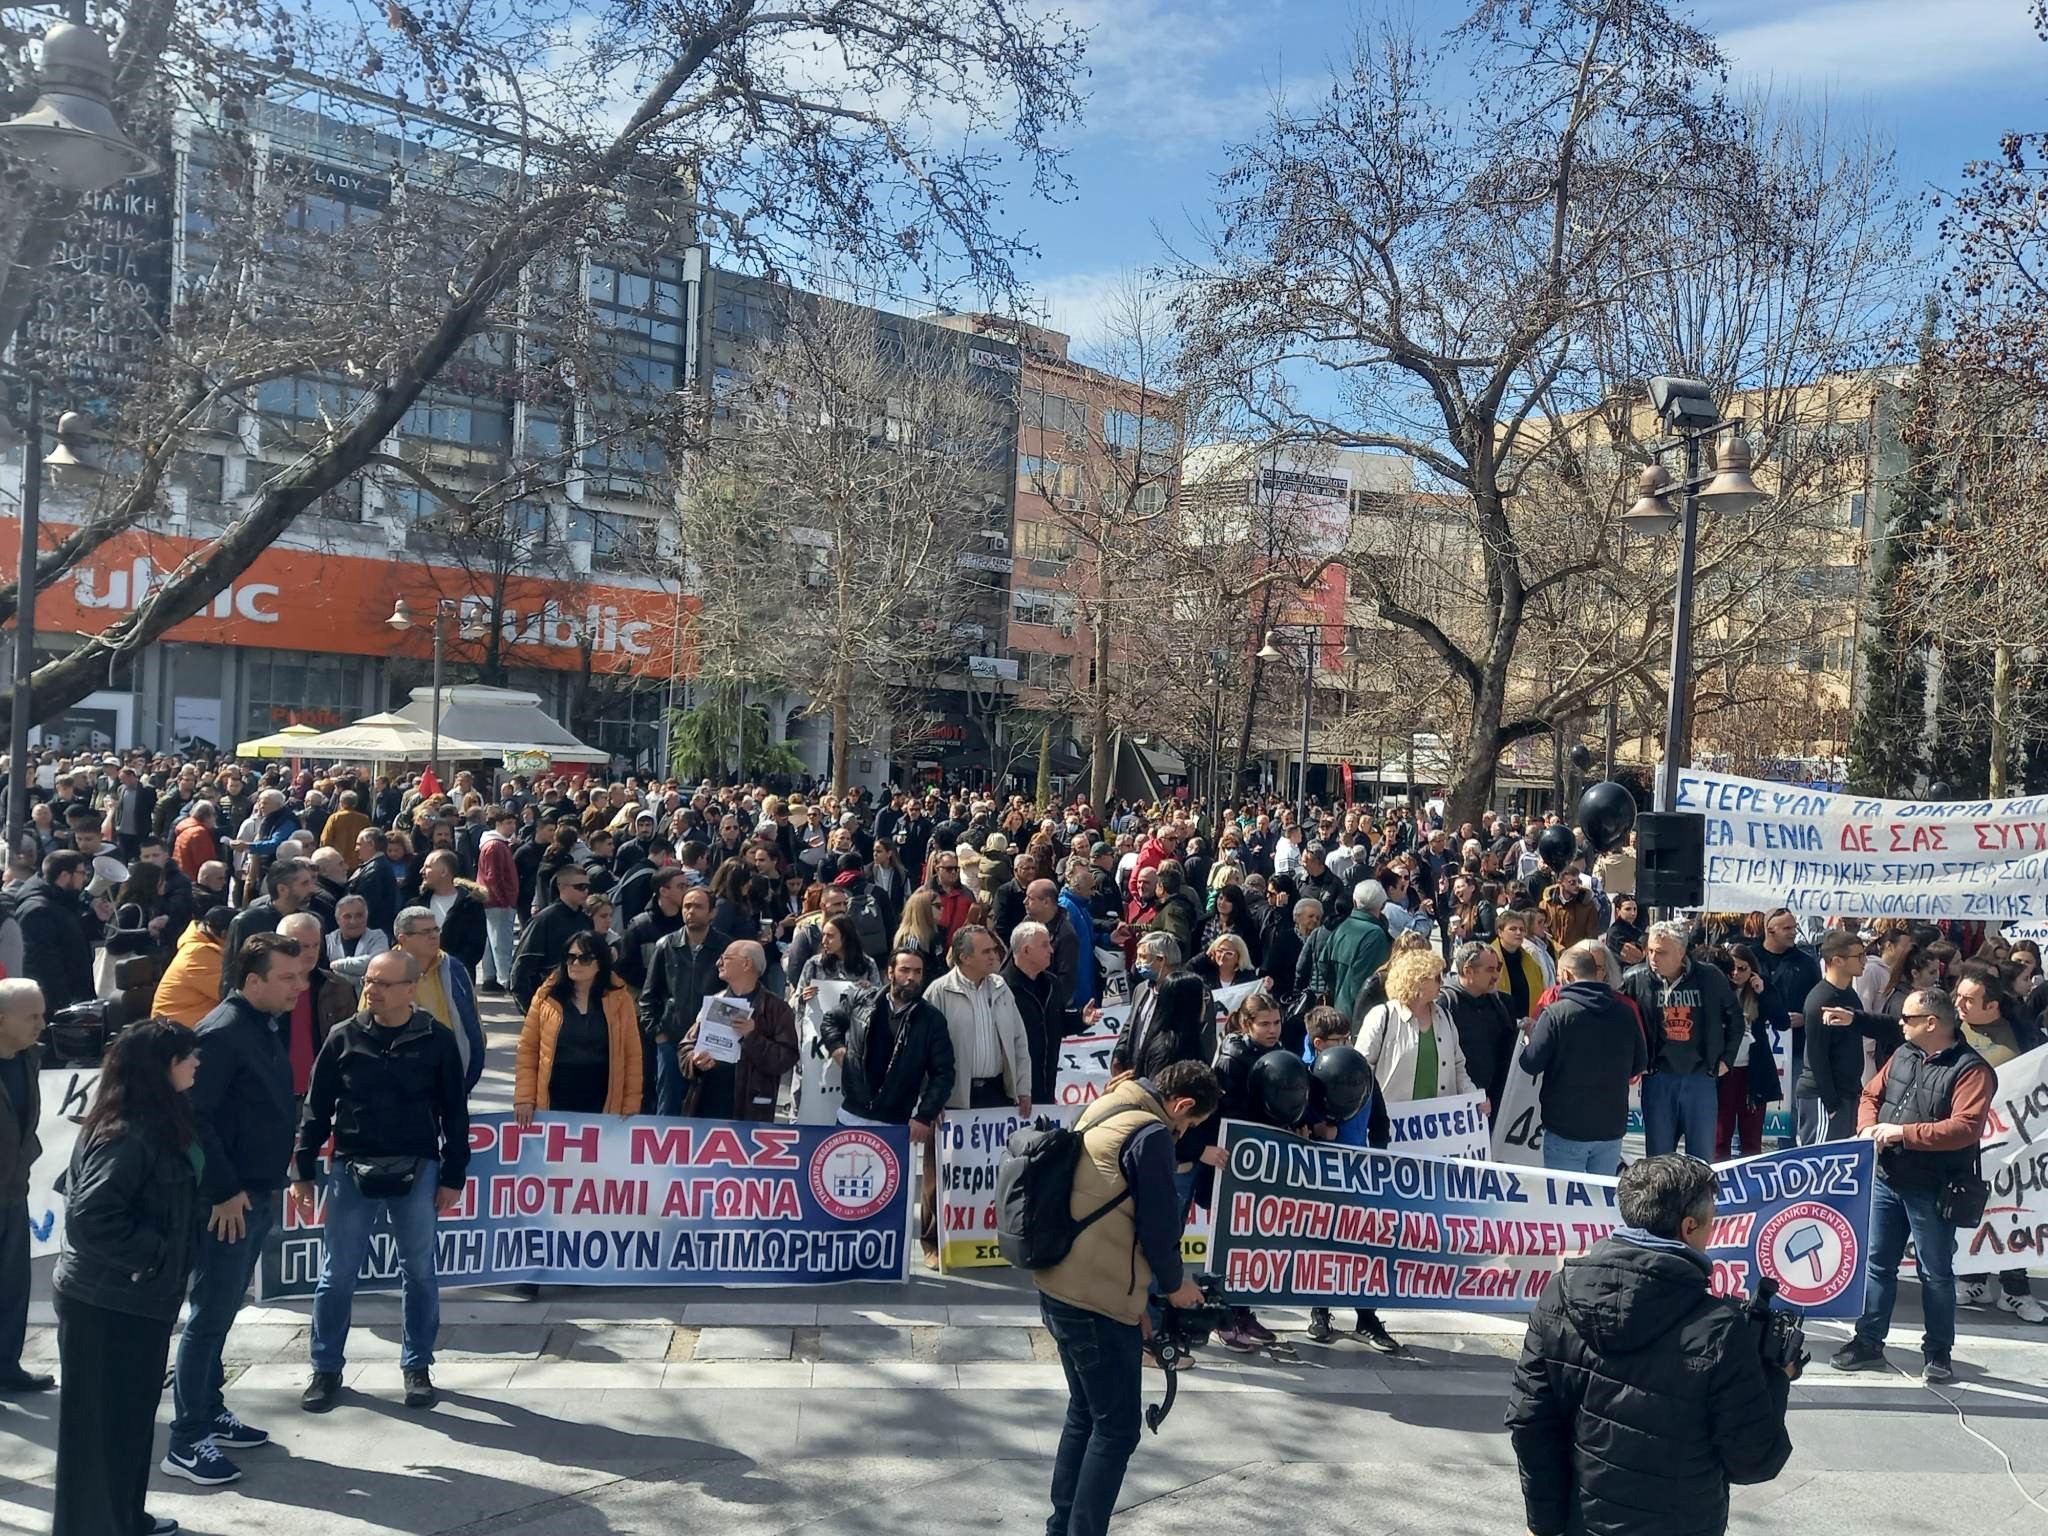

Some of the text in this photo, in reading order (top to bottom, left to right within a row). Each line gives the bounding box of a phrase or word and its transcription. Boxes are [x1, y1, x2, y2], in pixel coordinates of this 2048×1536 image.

[315, 168, 361, 190] LADY
[1675, 778, 2044, 818] ΣΤΕΡΕΨΑΝ ΤΑ ΔΑΚΡΥΑ ΚΑΙ
[1704, 818, 1734, 846] ΕΑ
[1746, 821, 1824, 851] ΓΕΝΙΑ
[1840, 822, 1878, 852] ΔΕ
[1889, 824, 1949, 852] ΣΑΣ
[630, 1125, 800, 1169] ΜΑΣ
[942, 1121, 965, 1150] Το
[1230, 1139, 1280, 1183] ΟΙ
[1287, 1145, 1438, 1201] ΝΕΚΡΟΙ
[1447, 1161, 1529, 1203] ΜΑΣ
[1749, 1153, 1859, 1202] ΤΟΥΣ
[489, 1174, 649, 1219] ΠΟΤΑΜΙ
[661, 1177, 803, 1221] ΑΓΩΝΑ
[1231, 1190, 1255, 1238] Η
[1257, 1195, 1335, 1242] ΟΡΓΗ
[1335, 1204, 1398, 1248] ΜΑΣ
[1399, 1211, 1442, 1254] ΝΑ
[1444, 1213, 1567, 1257] ΤΣΑΚΙΣΕΙ
[1811, 1207, 1850, 1239] ΚΕΝΤΡΟ
[493, 1228, 661, 1271] ΜΕΙΝΟΥΝ
[670, 1229, 897, 1272] ΑΤΙΜΩΡΗΤΟΙ
[1225, 1249, 1291, 1294] ΠΟΥ
[1291, 1250, 1391, 1296] ΜΕΤΡΑ
[1395, 1258, 1456, 1298] ΤΗΝ
[1456, 1265, 1523, 1301] ΖΩΗ
[1823, 1253, 1853, 1296] ΛΑΡΙΣΑΣ
